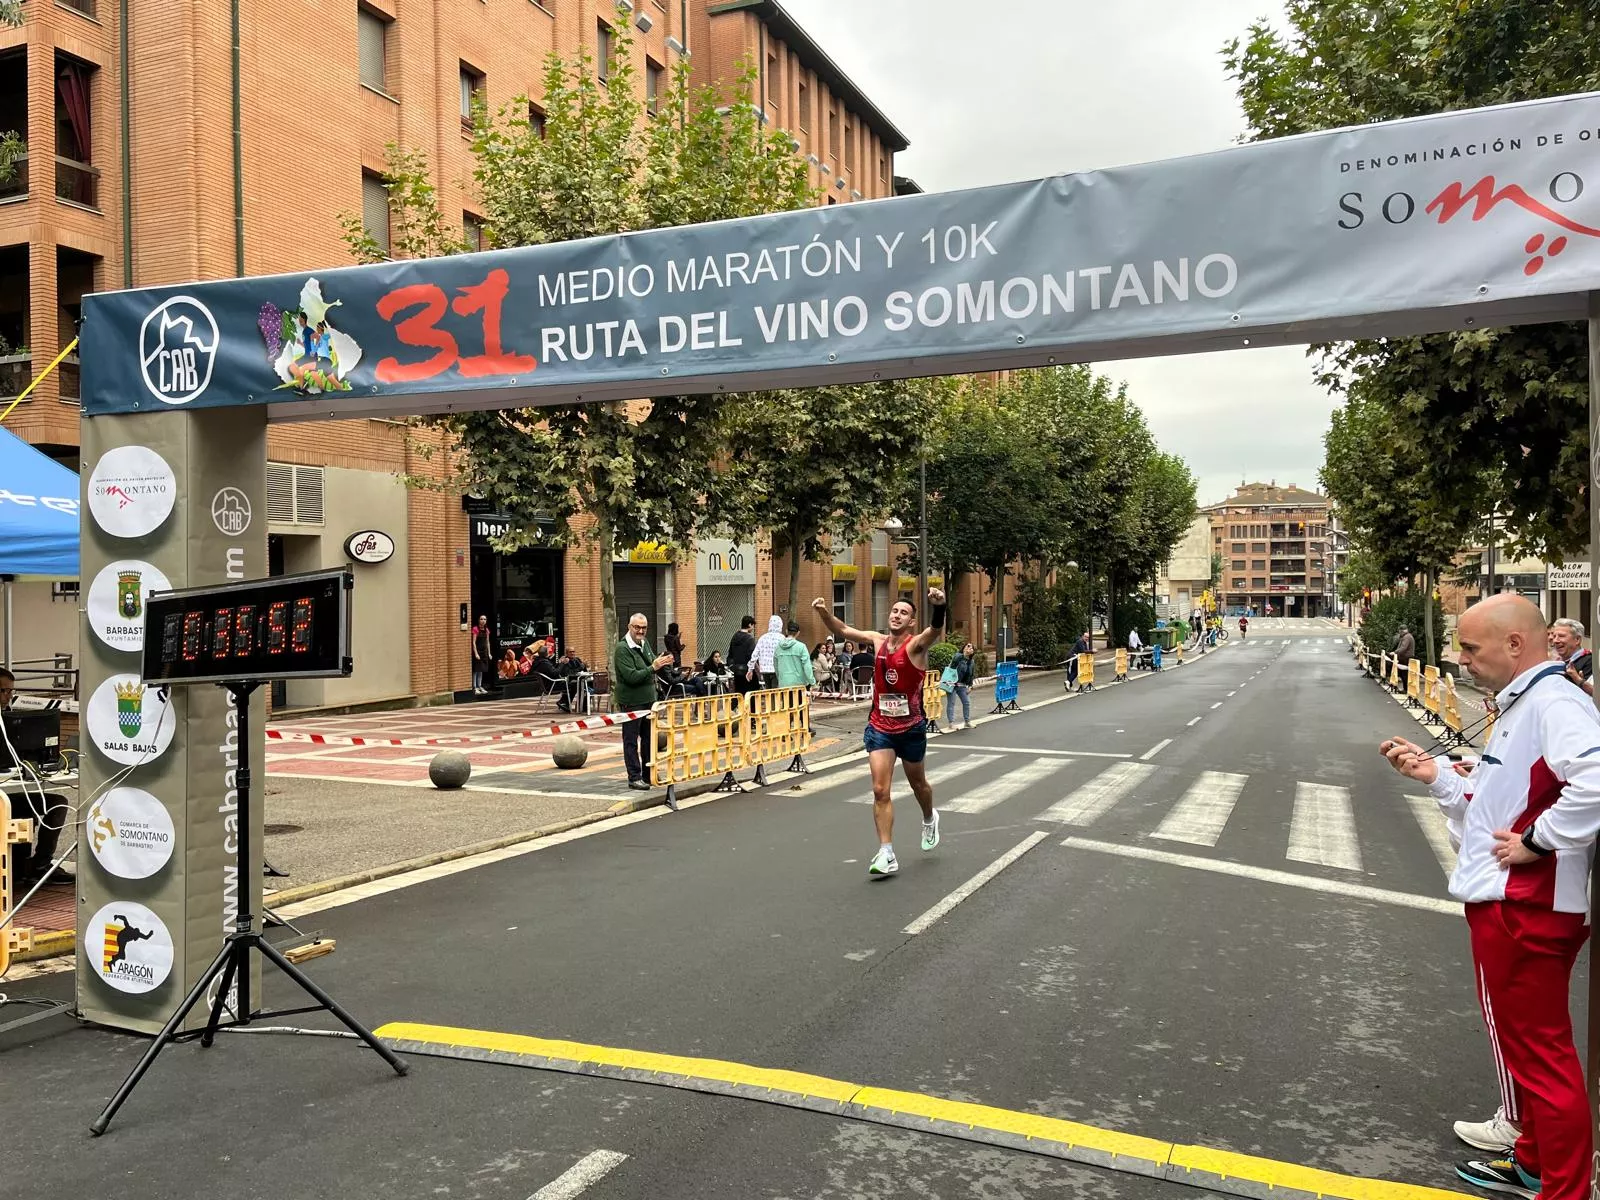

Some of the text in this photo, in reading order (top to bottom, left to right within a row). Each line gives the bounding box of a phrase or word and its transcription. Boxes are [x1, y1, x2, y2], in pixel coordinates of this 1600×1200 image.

[1340, 127, 1600, 174] DENOMINACIÓN DE O
[537, 220, 999, 307] MEDIO MARATÓN Y 10K
[541, 253, 1239, 364] RUTA DEL VINO SOMONTANO
[375, 268, 538, 383] 31
[160, 347, 199, 393] CAB
[222, 510, 242, 531] CAB
[106, 626, 144, 635] BARBAST
[104, 742, 157, 754] SALAS BAJAS
[120, 829, 168, 842] SOMONTANO
[118, 963, 153, 978] ARAGÓN
